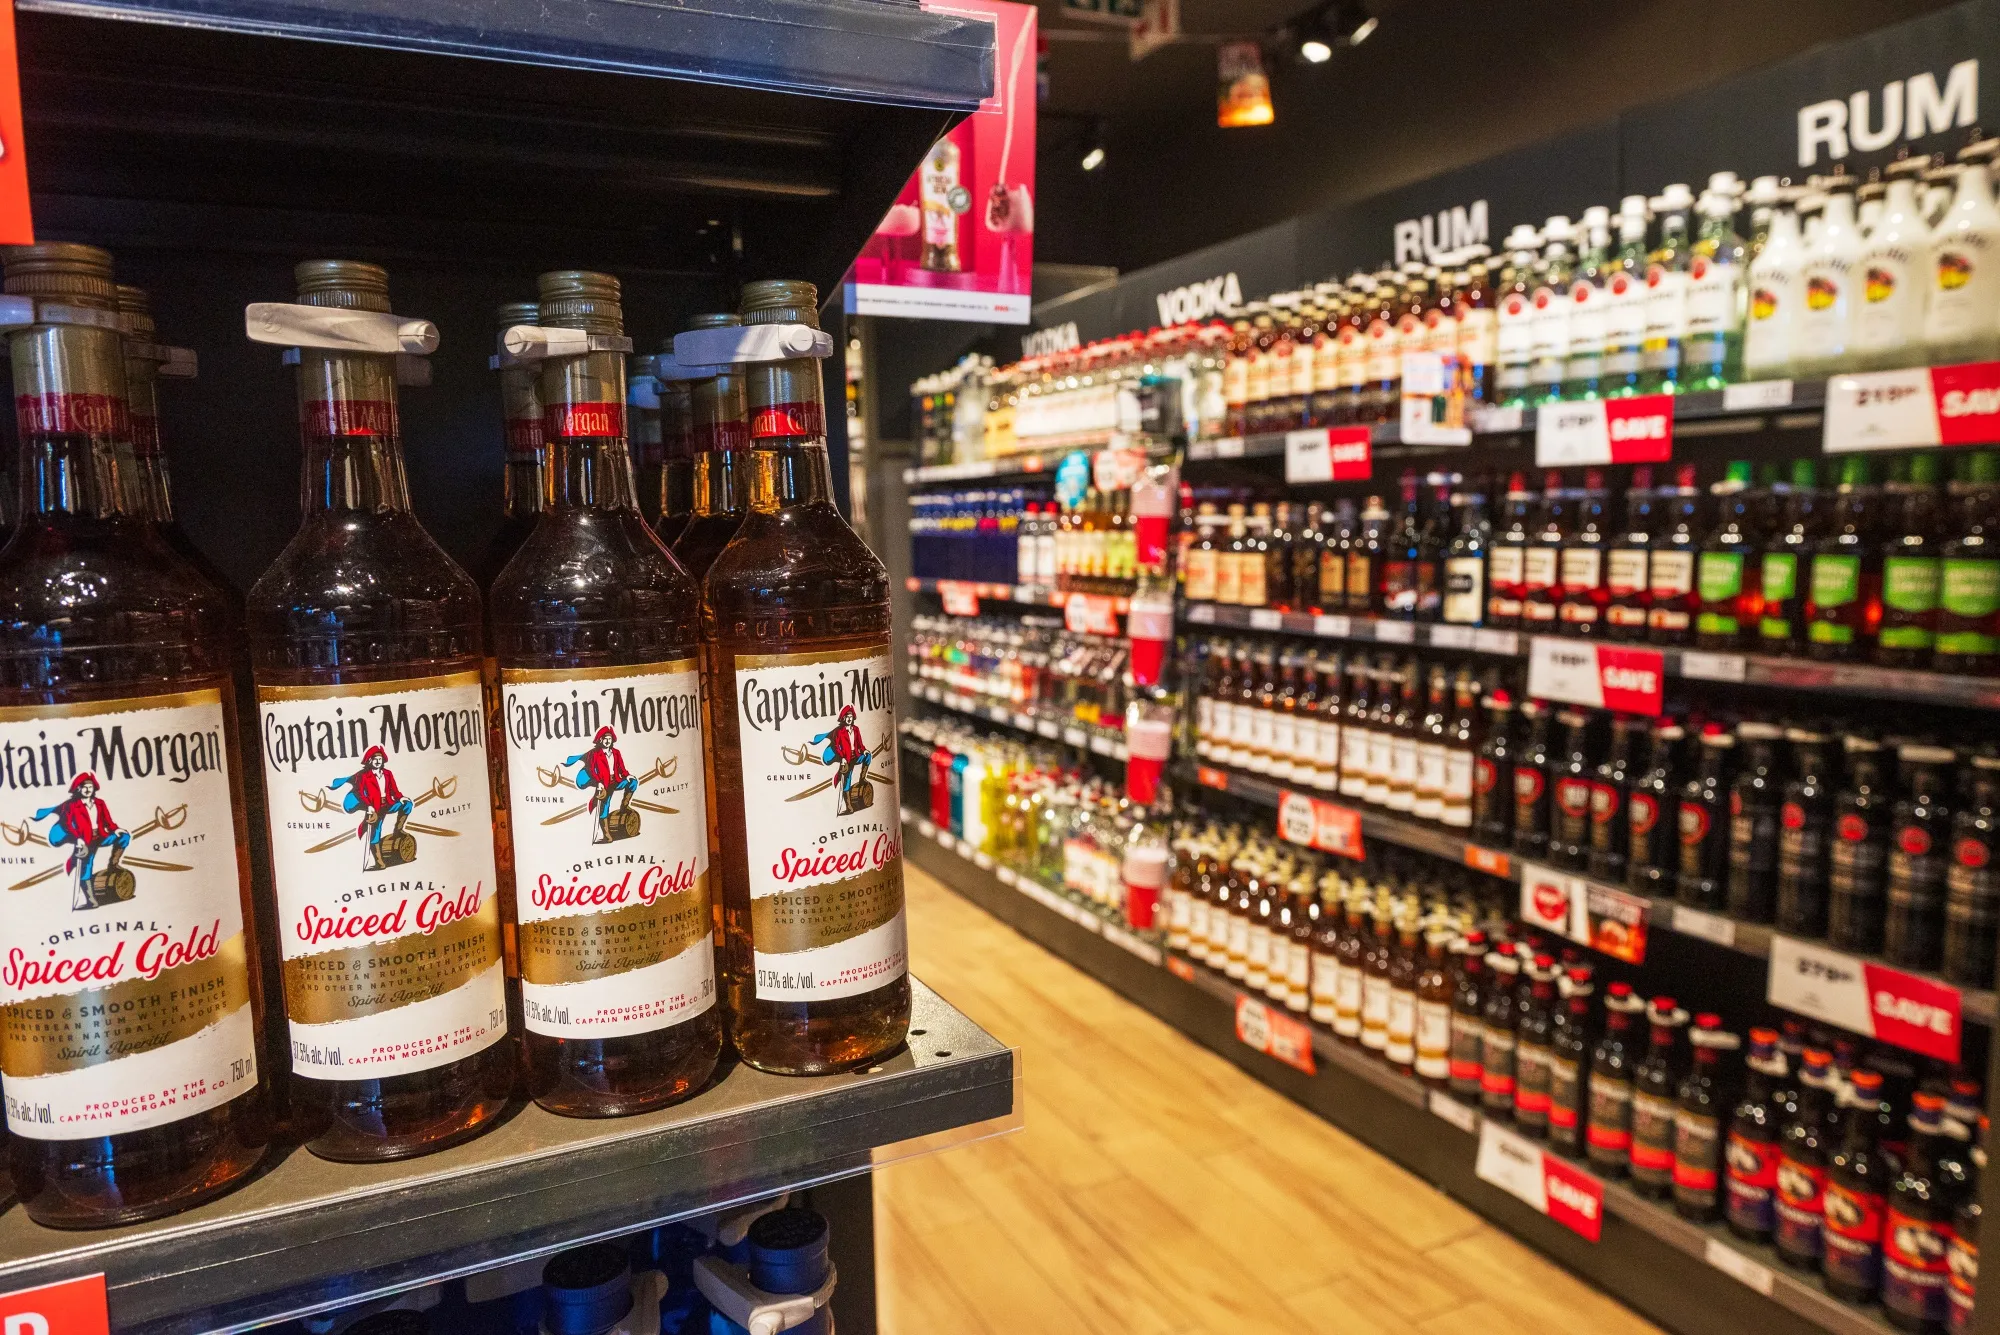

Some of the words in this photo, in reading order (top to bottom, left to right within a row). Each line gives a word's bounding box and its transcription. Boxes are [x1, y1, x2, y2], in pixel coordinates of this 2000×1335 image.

[1798, 58, 1979, 168] RUM
[1394, 199, 1489, 266] RUM
[1156, 271, 1243, 328] VODKA
[1939, 387, 2000, 418] SAV
[752, 412, 777, 438] gan
[1611, 415, 1667, 441] SAVE
[1603, 665, 1657, 694] SAVE
[742, 672, 843, 731] Captain
[844, 668, 894, 715] Morg
[507, 689, 599, 750] Captain
[601, 687, 699, 738] Morgan
[265, 707, 368, 773] Captain
[369, 703, 482, 756] Morgan
[0, 730, 77, 790] tain
[77, 725, 222, 783] Morgan
[653, 782, 689, 796] QUALITY
[767, 773, 811, 781] GENUINE
[287, 822, 331, 830] GENUINE
[430, 802, 472, 819] QUALITY
[153, 833, 206, 851] QUALITY
[818, 823, 884, 844] ORIGINAL
[572, 854, 657, 873] ORIGINAL
[772, 839, 868, 883] Spiced
[341, 881, 435, 903] ORIGINAL
[532, 872, 632, 911] Spiced
[638, 857, 697, 905] Gold
[773, 896, 820, 906] SPICED
[826, 894, 834, 903] &
[839, 883, 885, 901] SMOOTH
[296, 899, 408, 945] Spiced
[416, 880, 482, 934] Gold
[774, 905, 841, 915] CARIBBEAN
[847, 900, 868, 910] RUM
[800, 915, 834, 924] OTHER
[840, 905, 881, 920] NATURAL
[48, 920, 159, 945] ORIGINAL
[533, 924, 575, 937] SPICED
[581, 926, 589, 936] &
[595, 919, 656, 935] SMOOTH
[662, 907, 699, 926] FINISH
[820, 923, 853, 937] Spirit
[534, 937, 597, 945] CARIBBEAN
[605, 936, 630, 945] RUM
[639, 929, 668, 941] WITH
[534, 946, 550, 954] AND
[3, 941, 126, 991] Spiced
[135, 918, 221, 979] Gold
[299, 959, 346, 972] SPICED
[352, 959, 361, 970] &
[368, 950, 436, 968] SMOOTH
[443, 933, 485, 955] FINISH
[301, 973, 370, 981] CARIBBEAN
[380, 968, 408, 978] RUM
[417, 958, 451, 972] WITH
[457, 946, 486, 962] SPICE
[576, 959, 610, 971] Spirit
[840, 961, 882, 977] PRODUCED
[884, 956, 892, 965] BY
[324, 983, 363, 992] OTHER
[370, 975, 430, 990] NATURAL
[437, 956, 487, 978] FLAVOURS
[758, 969, 781, 989] 37.5%
[782, 972, 816, 989] alc./vol.
[820, 974, 859, 987] CAPTAIN
[862, 965, 892, 980] MORGAN
[7, 1007, 54, 1020] SPICED
[62, 1006, 72, 1019] &
[80, 995, 162, 1018] SMOOTH
[170, 976, 225, 1001] FINISH
[347, 995, 387, 1008] Spirit
[389, 982, 445, 1003] Aperitif
[597, 1003, 650, 1016] PRODUCED
[655, 1000, 666, 1008] BY
[670, 994, 685, 1003] THE
[8, 1022, 82, 1032] CARIBBEAN
[93, 1016, 127, 1027] RUM
[138, 1005, 179, 1021] WITH
[188, 990, 227, 1008] SPICE
[9, 1033, 27, 1042] AND
[33, 1033, 74, 1043] OTHER
[83, 1022, 153, 1041] NATURAL
[162, 1001, 228, 1027] FLAVOURS
[542, 1006, 571, 1025] alc./vol.
[576, 1016, 618, 1025] CAPTAIN
[623, 1007, 665, 1021] MORGAN
[669, 1001, 686, 1012] RUM
[1874, 990, 1953, 1036] SAVE
[57, 1045, 101, 1060] Spirit
[105, 1031, 172, 1056] Aperitif
[348, 1053, 395, 1065] CAPTAIN
[402, 1042, 449, 1058] MORGAN
[453, 1034, 472, 1046] RUM
[372, 1038, 431, 1054] PRODUCED
[437, 1034, 449, 1042] BY
[453, 1026, 471, 1037] THE
[311, 1046, 344, 1066] alc./vol.
[231, 1059, 244, 1083] 750
[59, 1111, 112, 1123] CAPTAIN
[120, 1096, 176, 1116] MORGAN
[183, 1087, 207, 1101] RUM
[212, 1080, 229, 1091] CO.
[86, 1093, 156, 1111] PRODUCED
[163, 1087, 178, 1098] BY
[184, 1079, 205, 1091] THE
[1547, 1175, 1598, 1220] SAVE
